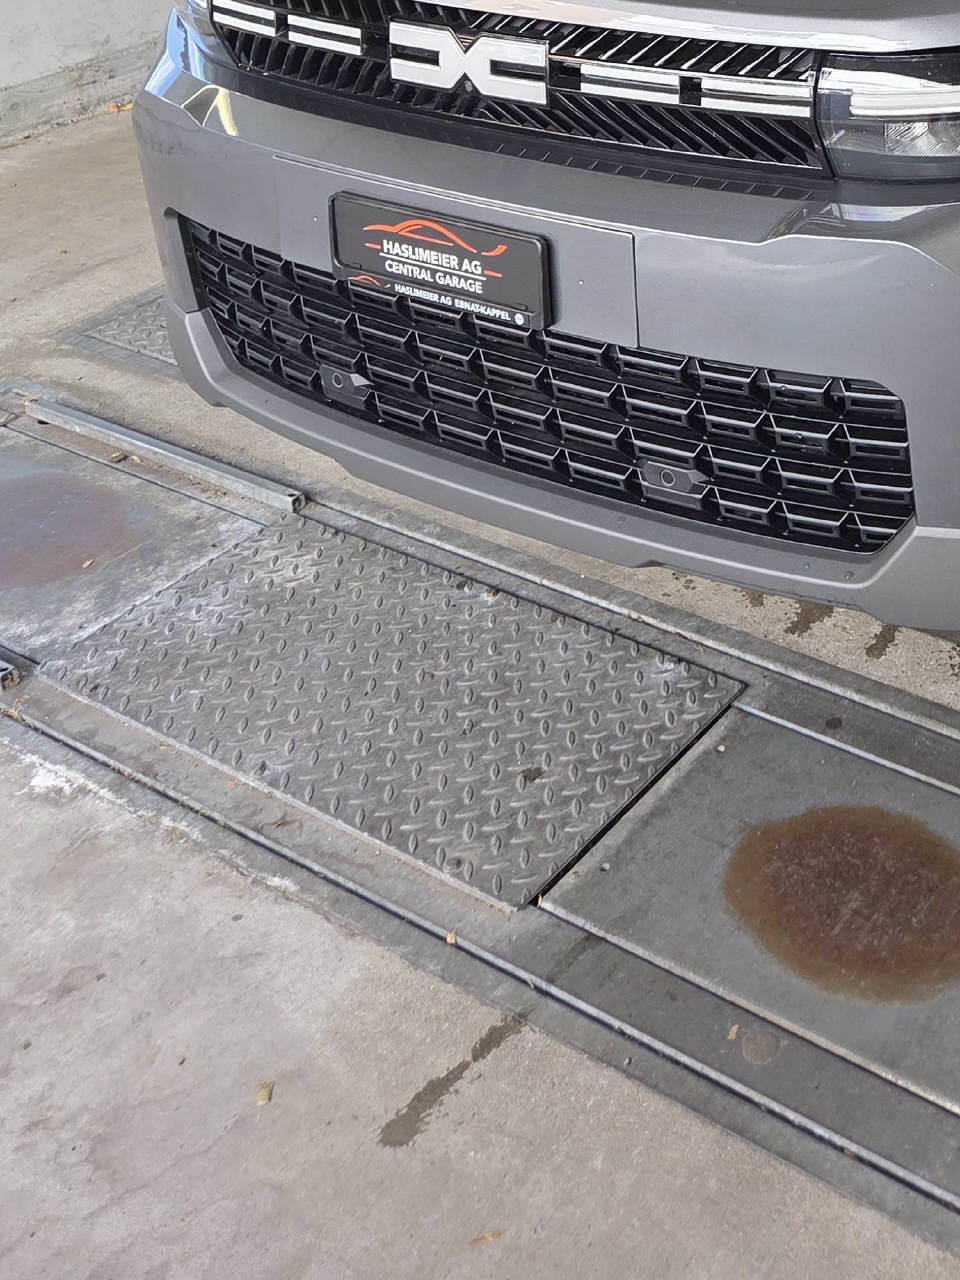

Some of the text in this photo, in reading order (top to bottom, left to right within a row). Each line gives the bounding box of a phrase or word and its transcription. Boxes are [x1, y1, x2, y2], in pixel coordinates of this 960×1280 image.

[383, 239, 482, 275] HASLIMEIER AG
[385, 259, 483, 294] CENTRAL GARAGE
[394, 283, 439, 303] HASLIMEIER
[440, 295, 452, 305] AG
